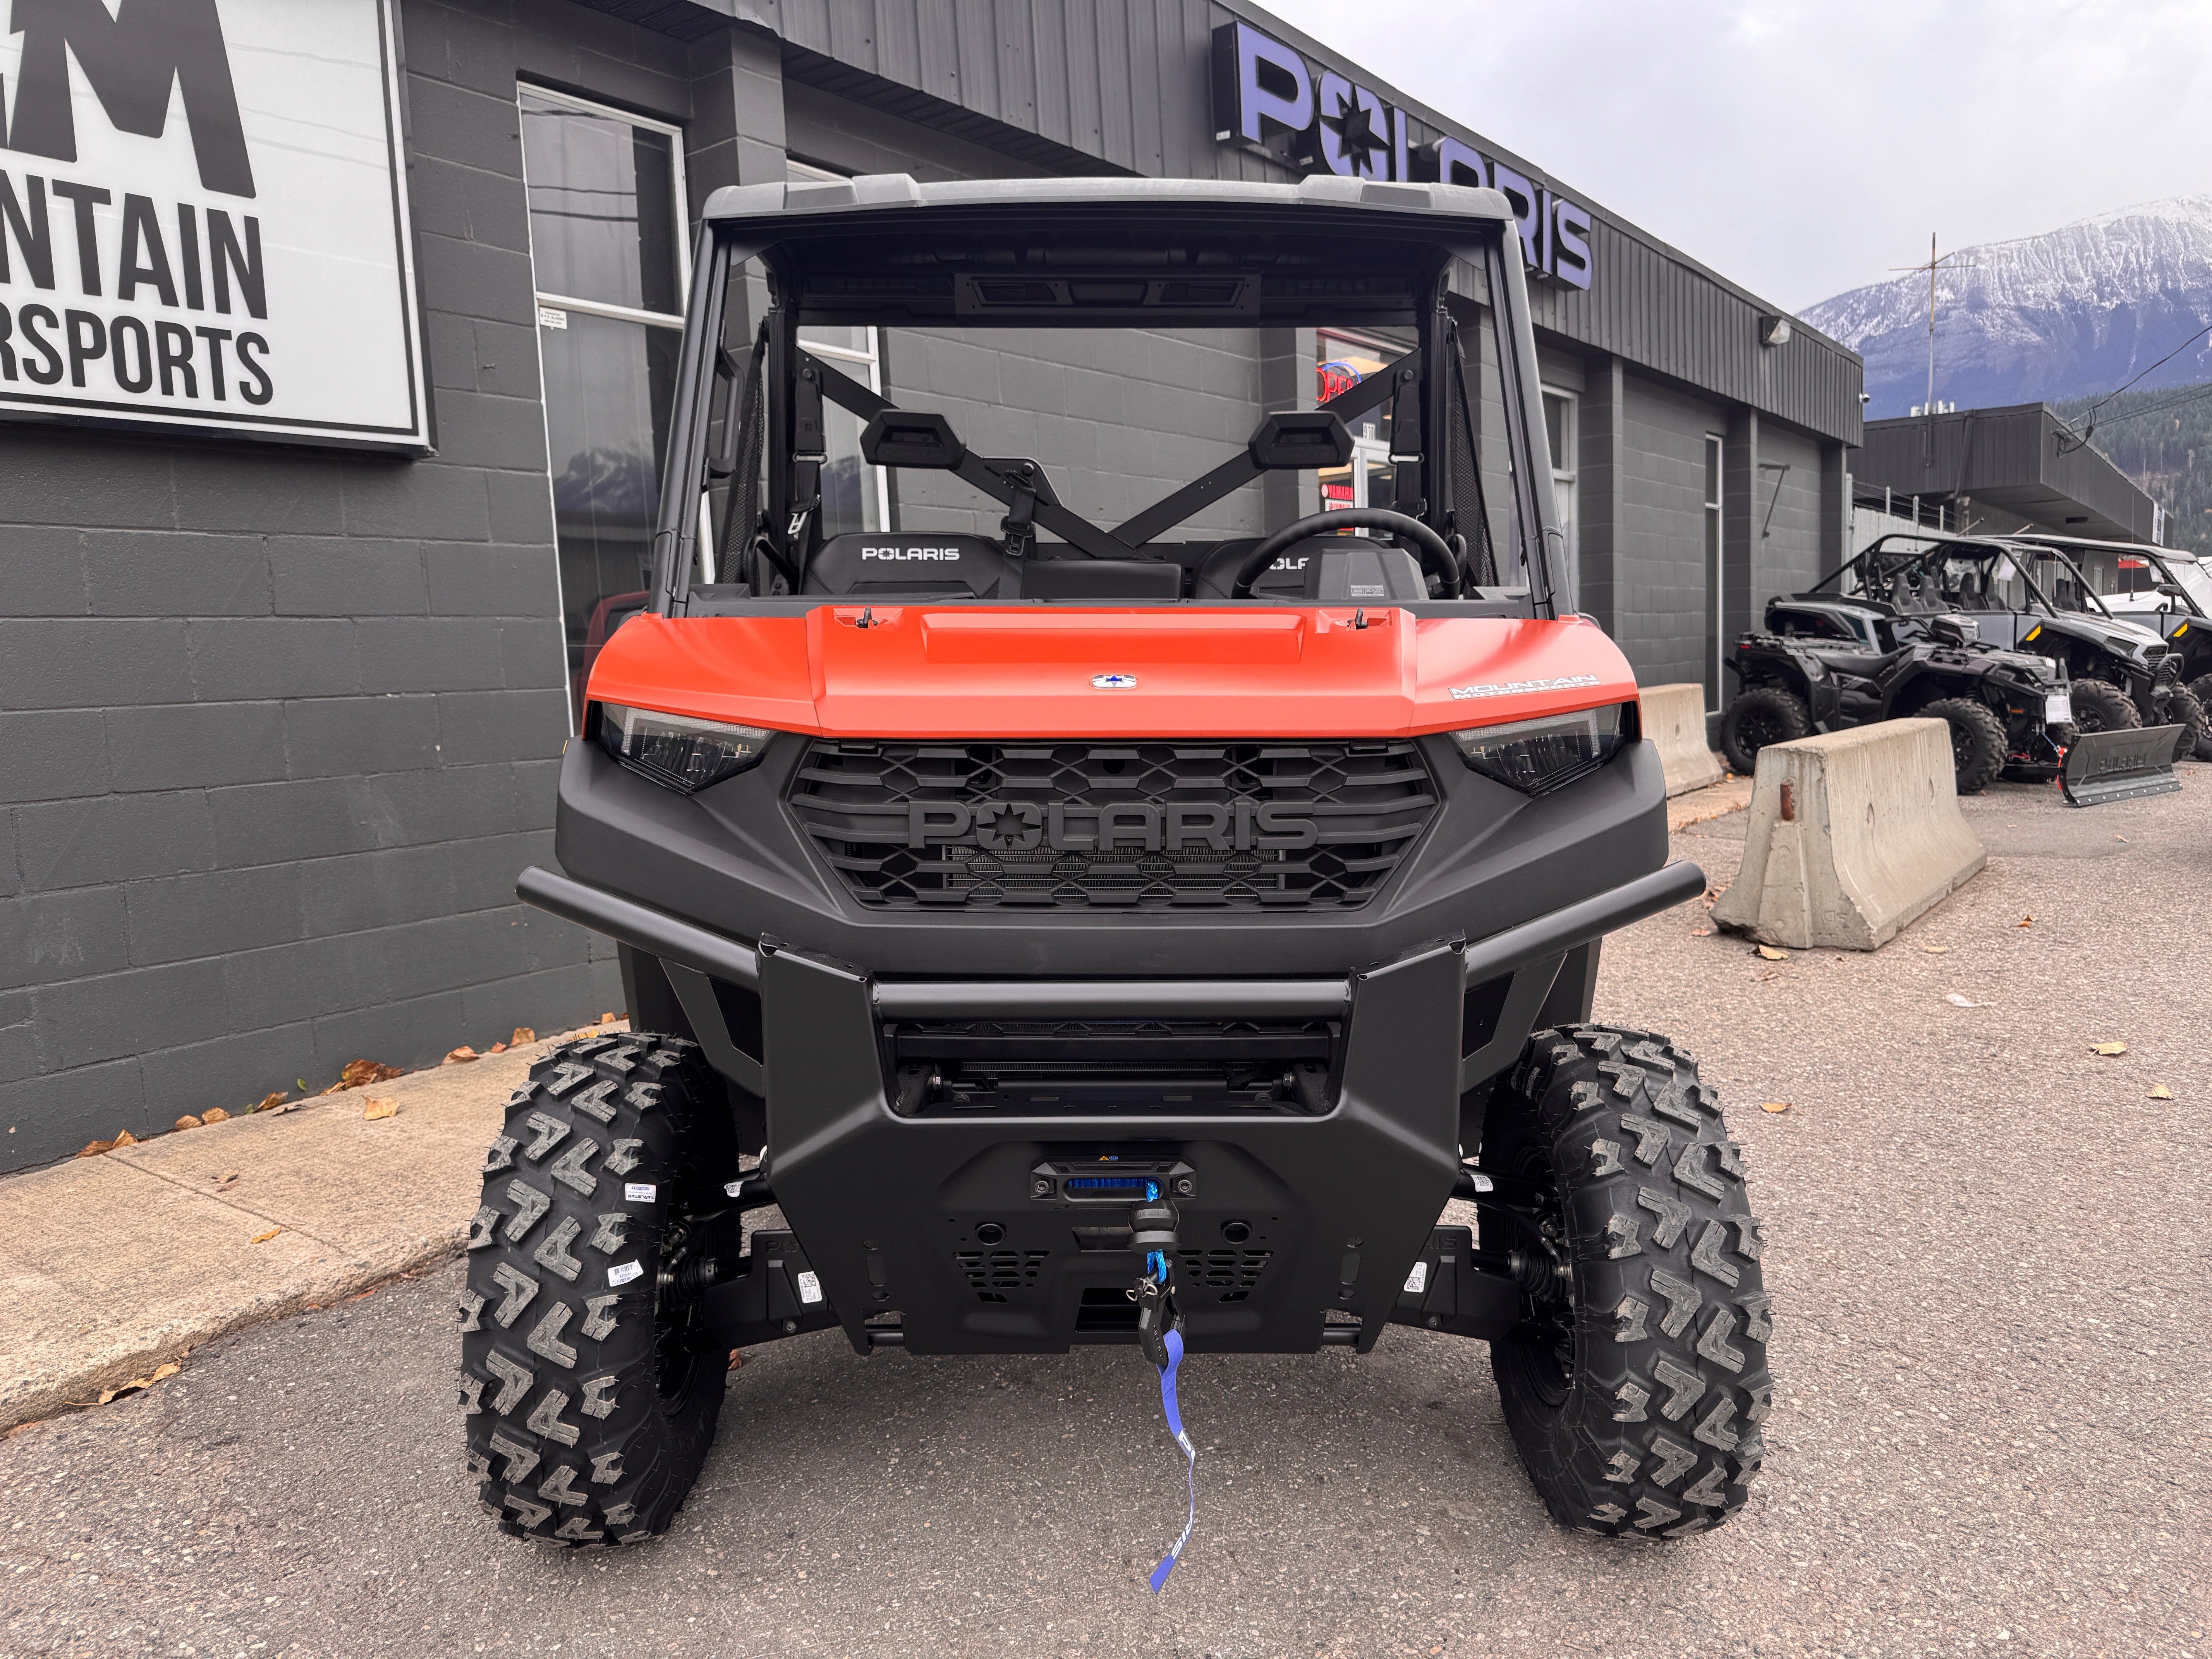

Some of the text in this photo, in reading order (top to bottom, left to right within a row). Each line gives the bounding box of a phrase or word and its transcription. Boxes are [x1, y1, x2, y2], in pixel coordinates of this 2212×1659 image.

[1328, 484, 1353, 501] YAMAHA
[862, 548, 960, 560] POLARIS
[1450, 674, 1597, 695] MOUNTAIN
[908, 799, 1318, 851] POLARIS
